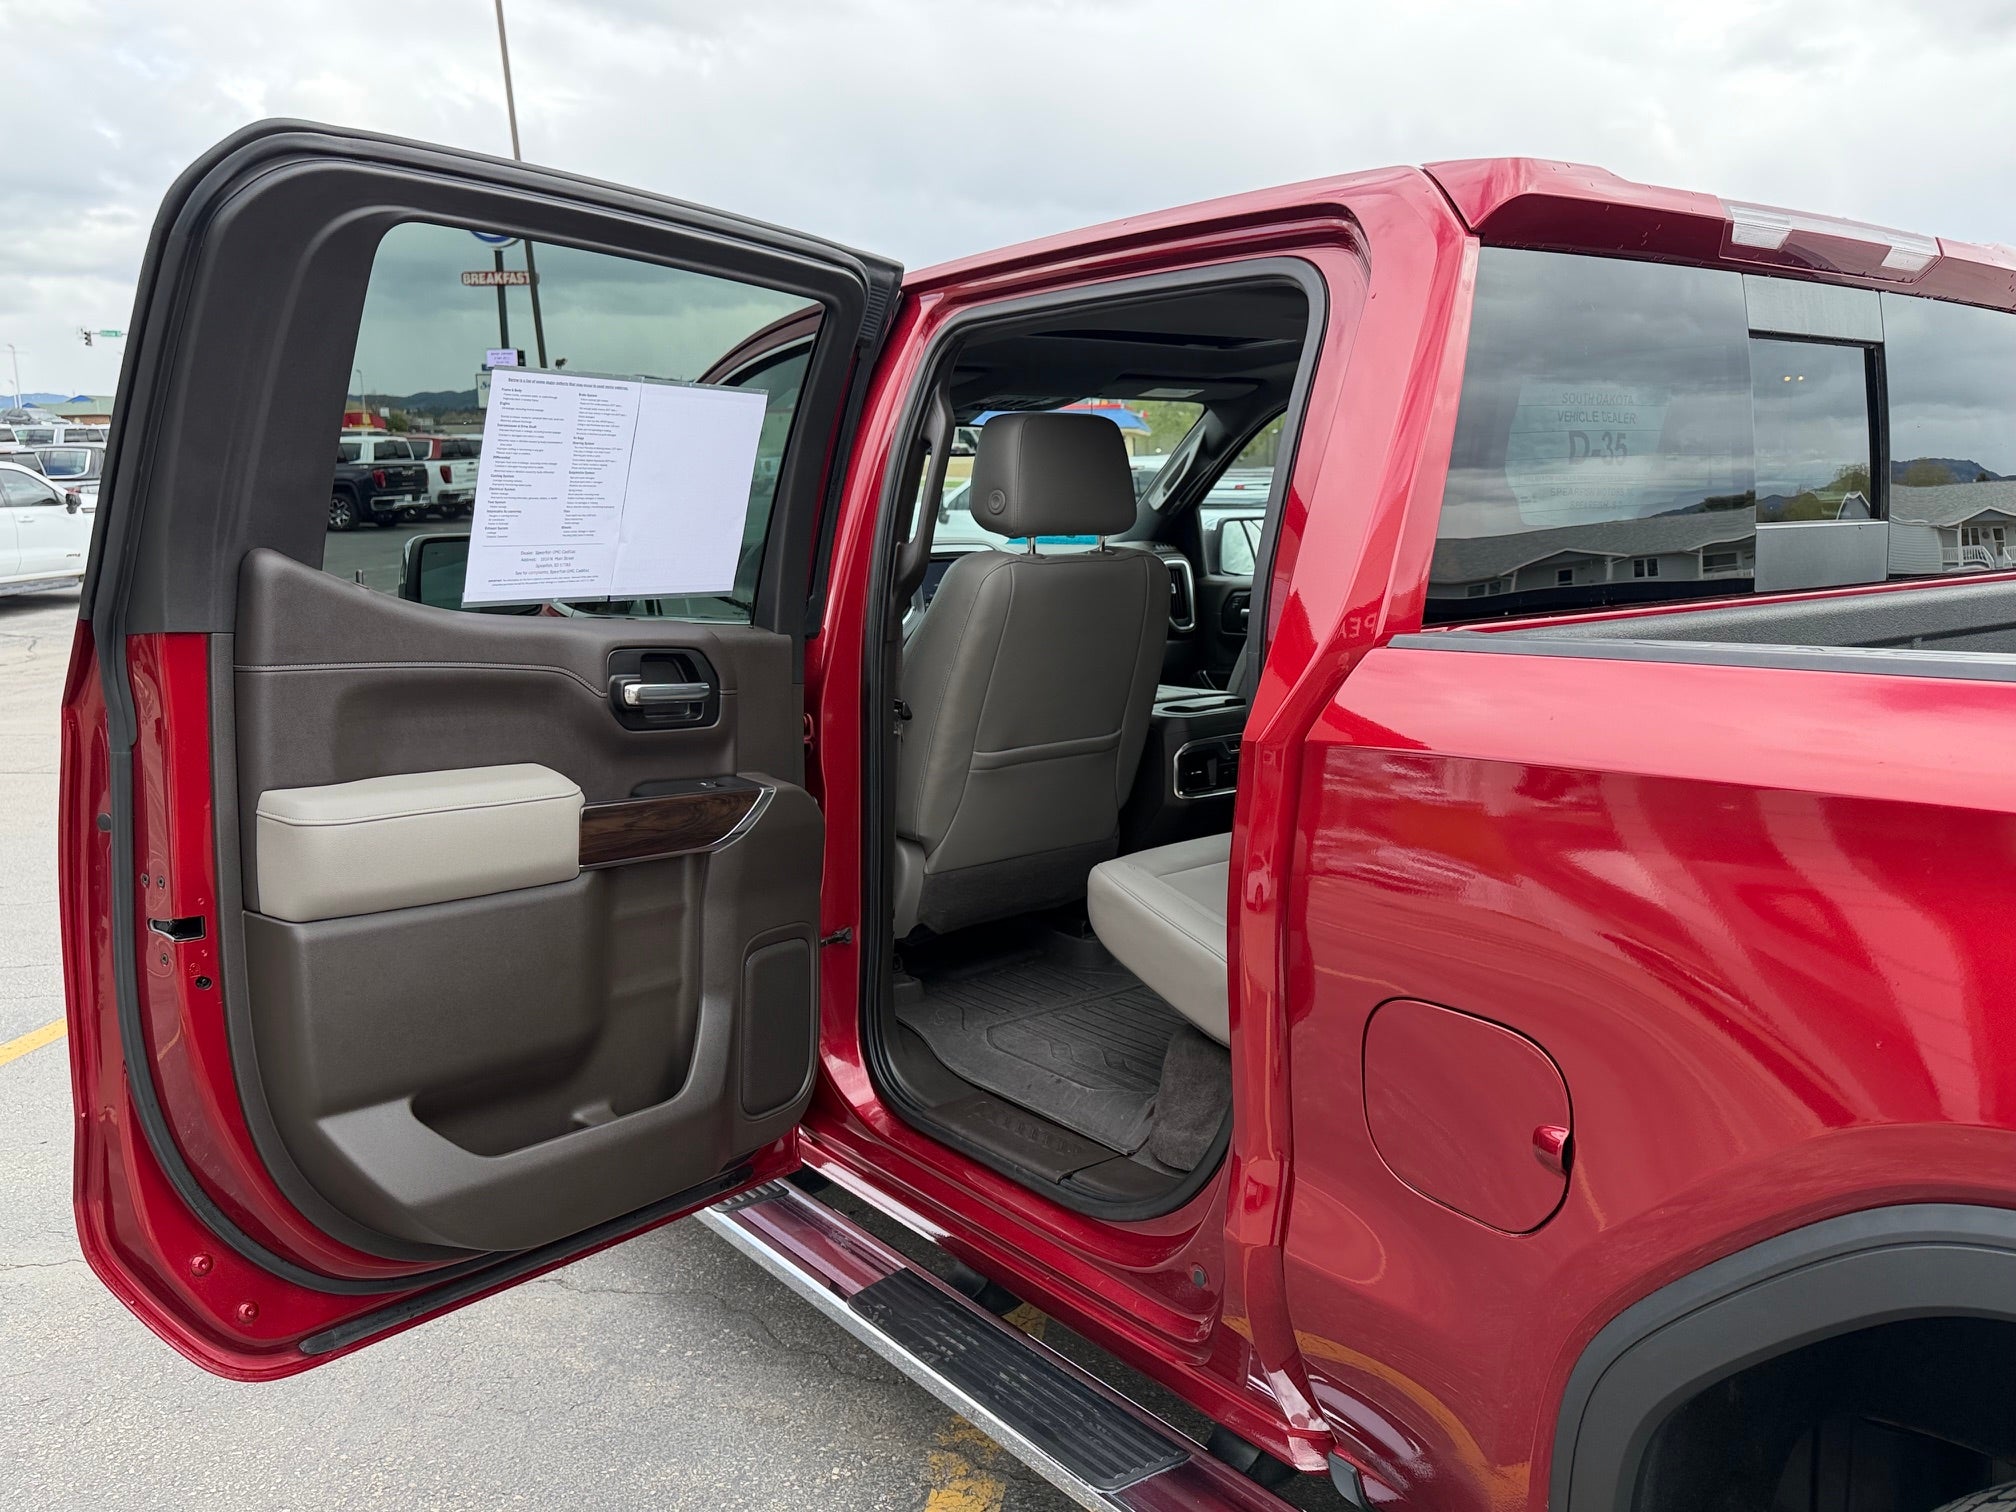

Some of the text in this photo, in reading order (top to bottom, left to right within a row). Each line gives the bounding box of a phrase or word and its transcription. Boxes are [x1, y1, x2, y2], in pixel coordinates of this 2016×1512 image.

[462, 272, 531, 286] BREAKFAST
[1561, 392, 1635, 406] SOUTH DAKOTA
[1557, 409, 1638, 425] VEHICLE DEALER
[1569, 430, 1628, 465] D-35
